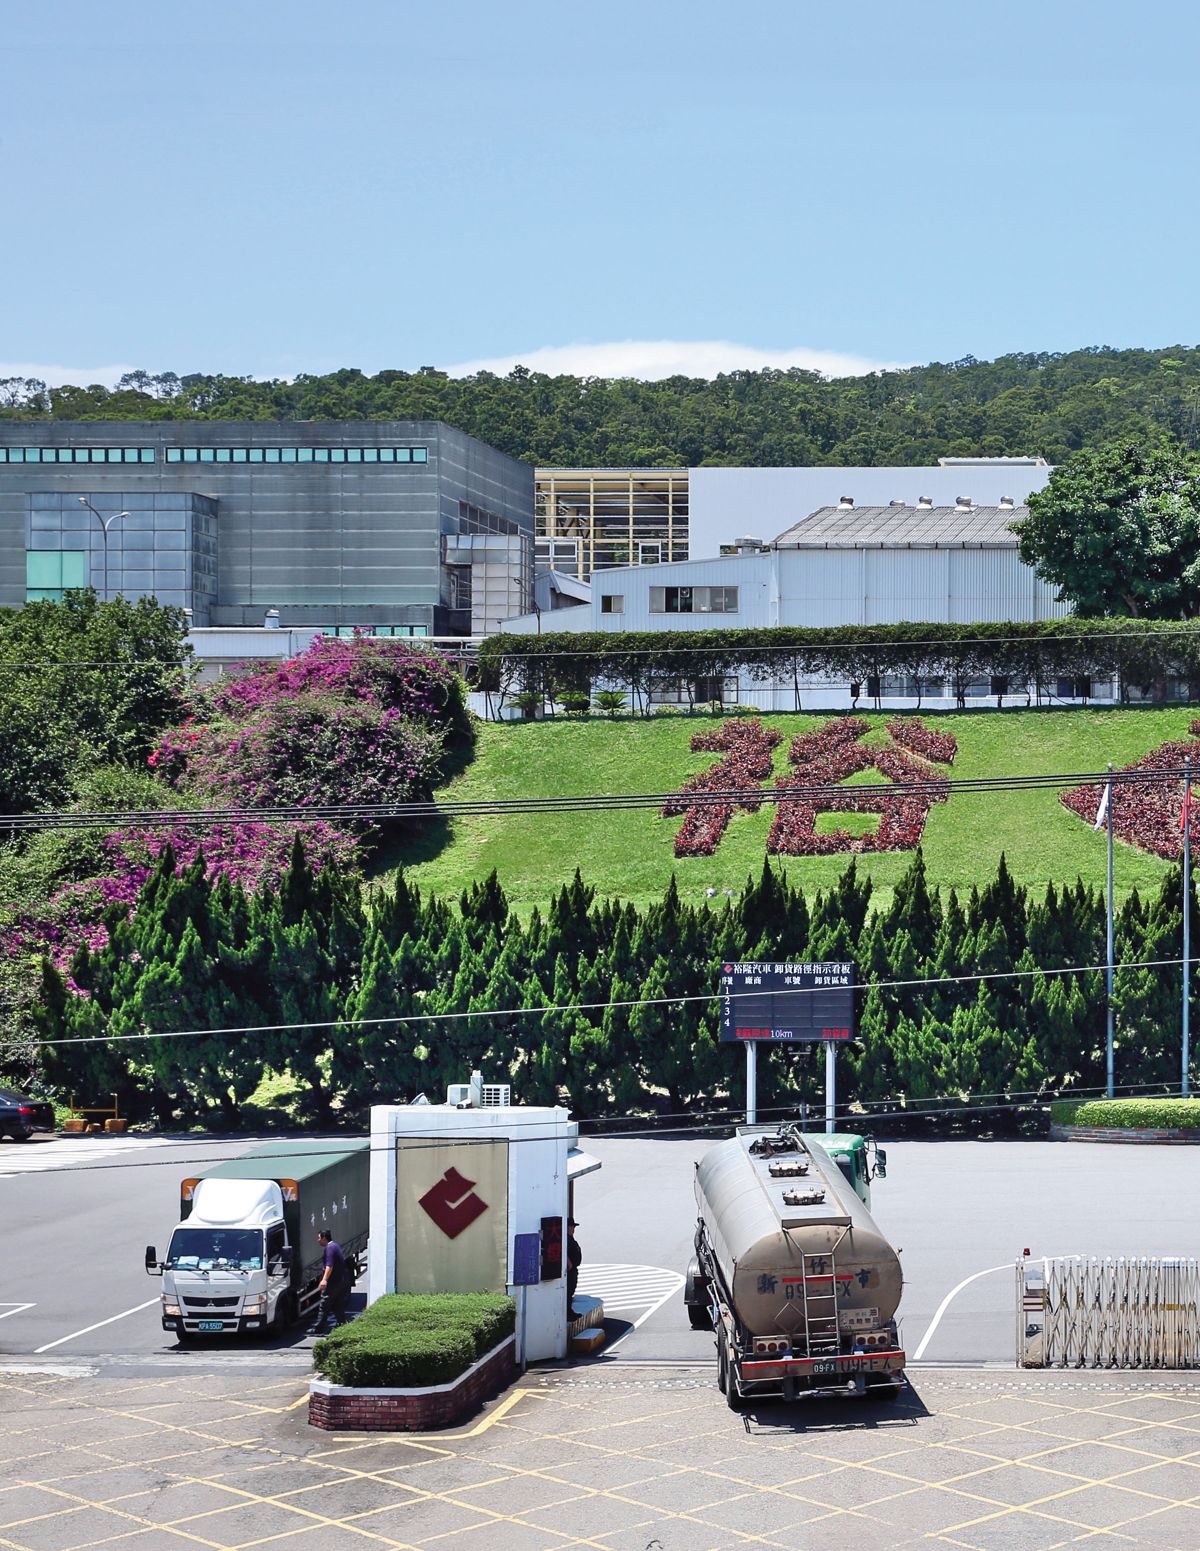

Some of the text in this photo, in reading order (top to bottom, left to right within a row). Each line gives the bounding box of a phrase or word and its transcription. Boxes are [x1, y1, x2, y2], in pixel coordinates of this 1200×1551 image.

[661, 715, 958, 858] 裕
[733, 964, 772, 974] 裕隆汽車
[784, 976, 801, 985] 車號
[814, 976, 849, 985] 卸貨區域
[724, 996, 731, 1005] 2
[724, 1007, 730, 1016] 3
[724, 1018, 730, 1027] 4
[770, 1029, 793, 1038] 10km
